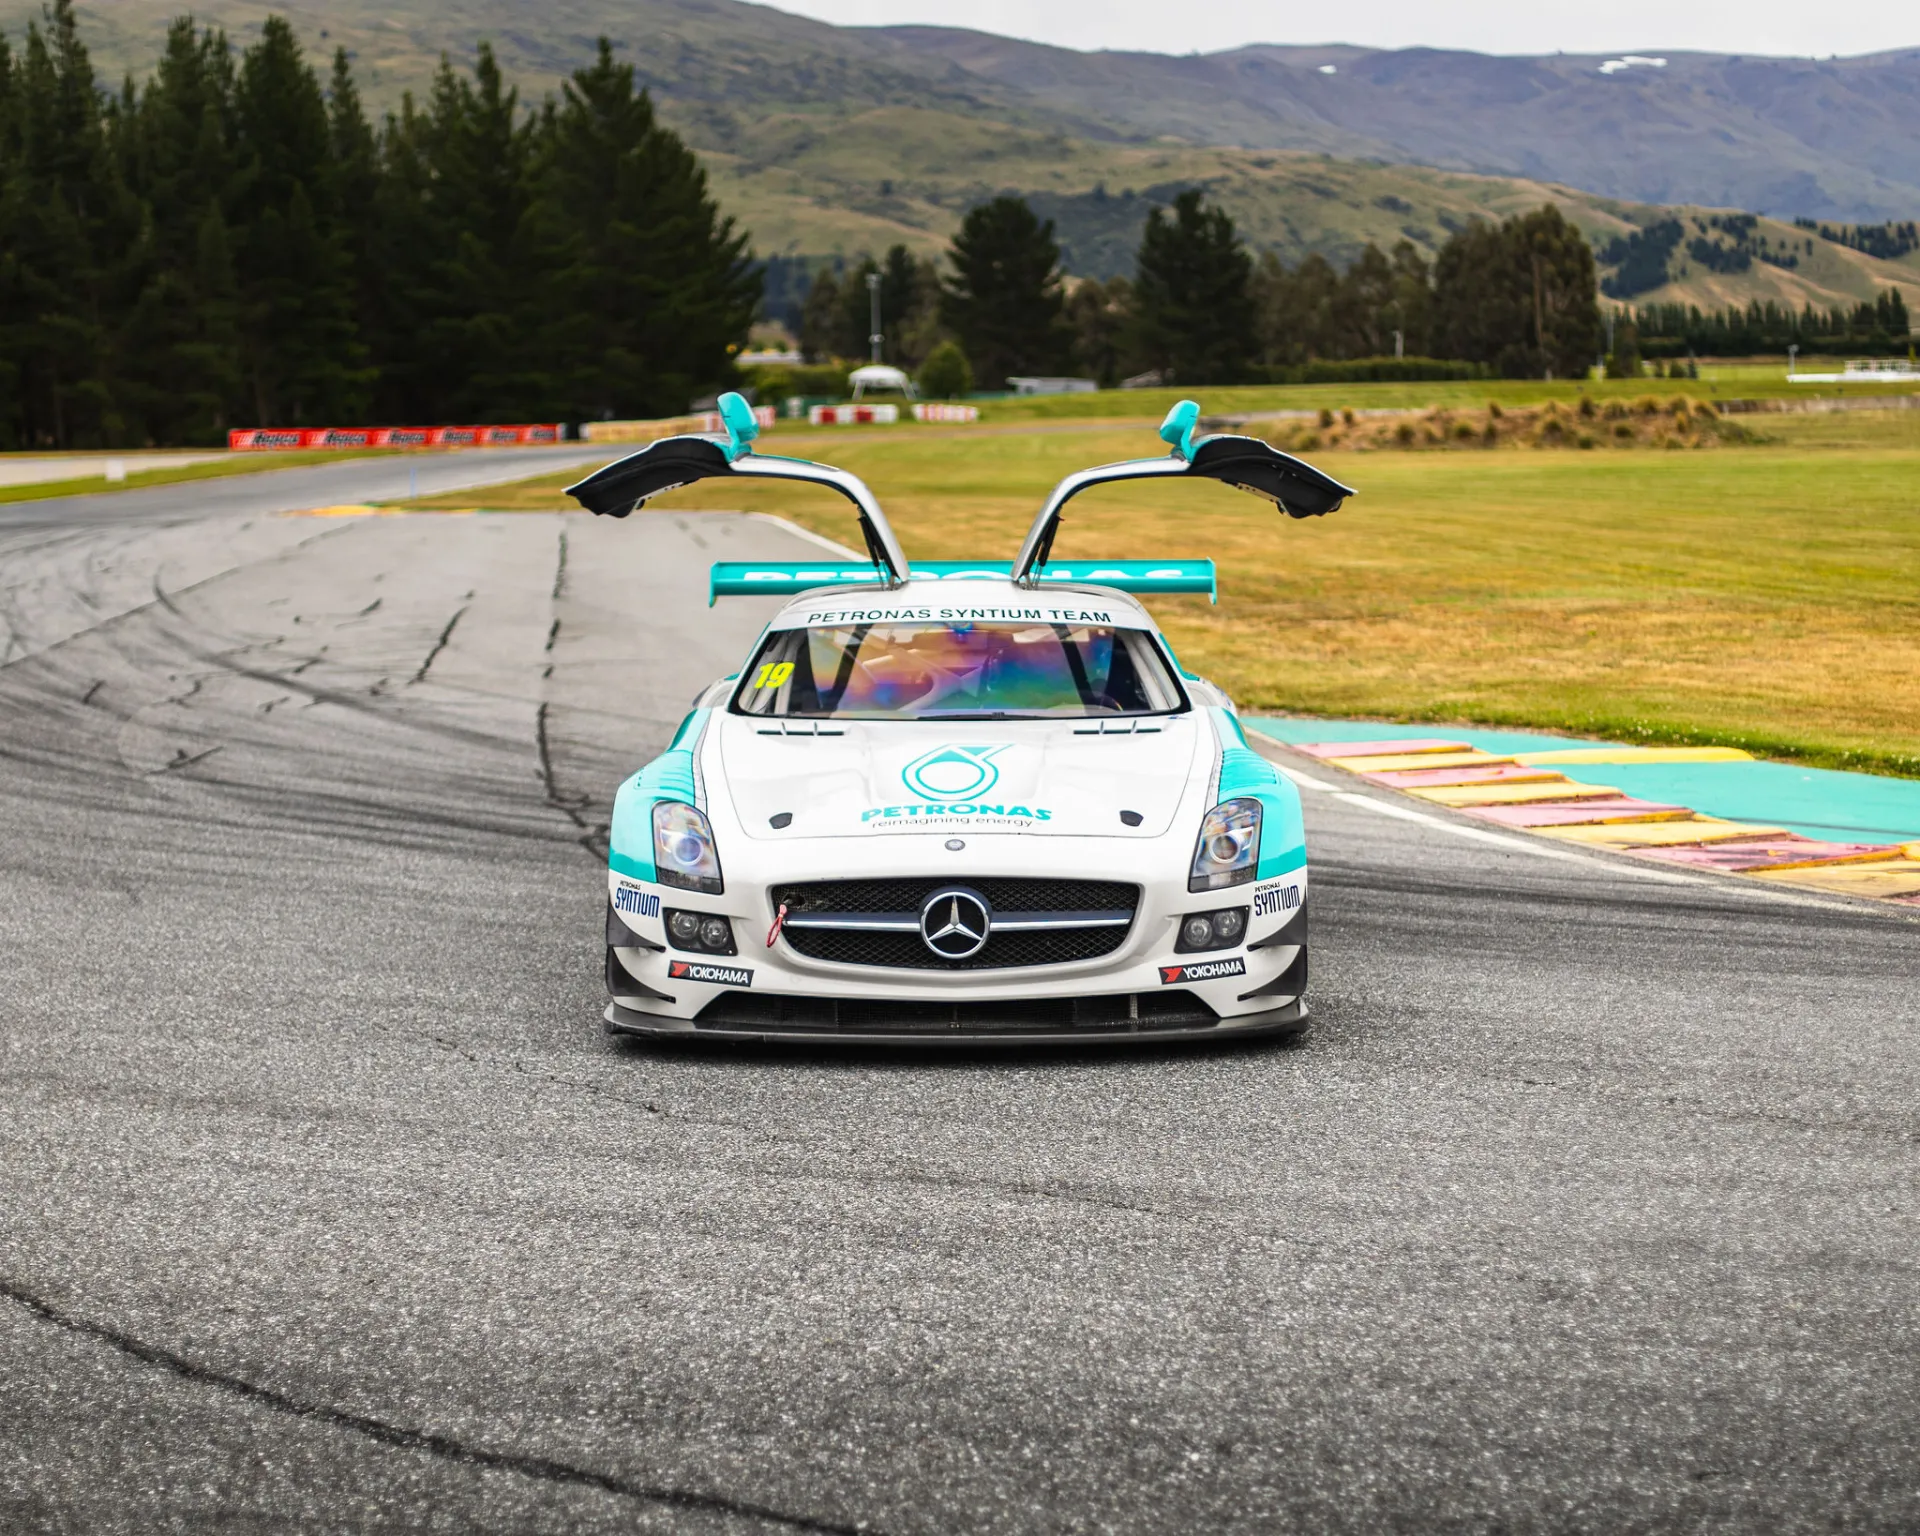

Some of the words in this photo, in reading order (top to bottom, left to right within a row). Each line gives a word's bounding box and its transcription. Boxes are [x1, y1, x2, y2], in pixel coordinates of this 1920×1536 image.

[808, 609, 931, 624] PETRONAS
[940, 608, 1041, 619] SYNTIUM
[1048, 609, 1112, 623] TEAM
[754, 662, 795, 689] 19
[861, 803, 1052, 822] PETRONAS
[872, 817, 970, 828] reimagining
[976, 818, 1033, 828] energy
[1254, 882, 1281, 892] PETRONAS
[615, 887, 660, 918] SYNTIUM
[1254, 885, 1301, 917] SYNTIUM
[688, 966, 749, 983] YOKOHAMA
[1183, 961, 1244, 979] YOKOHAMA
